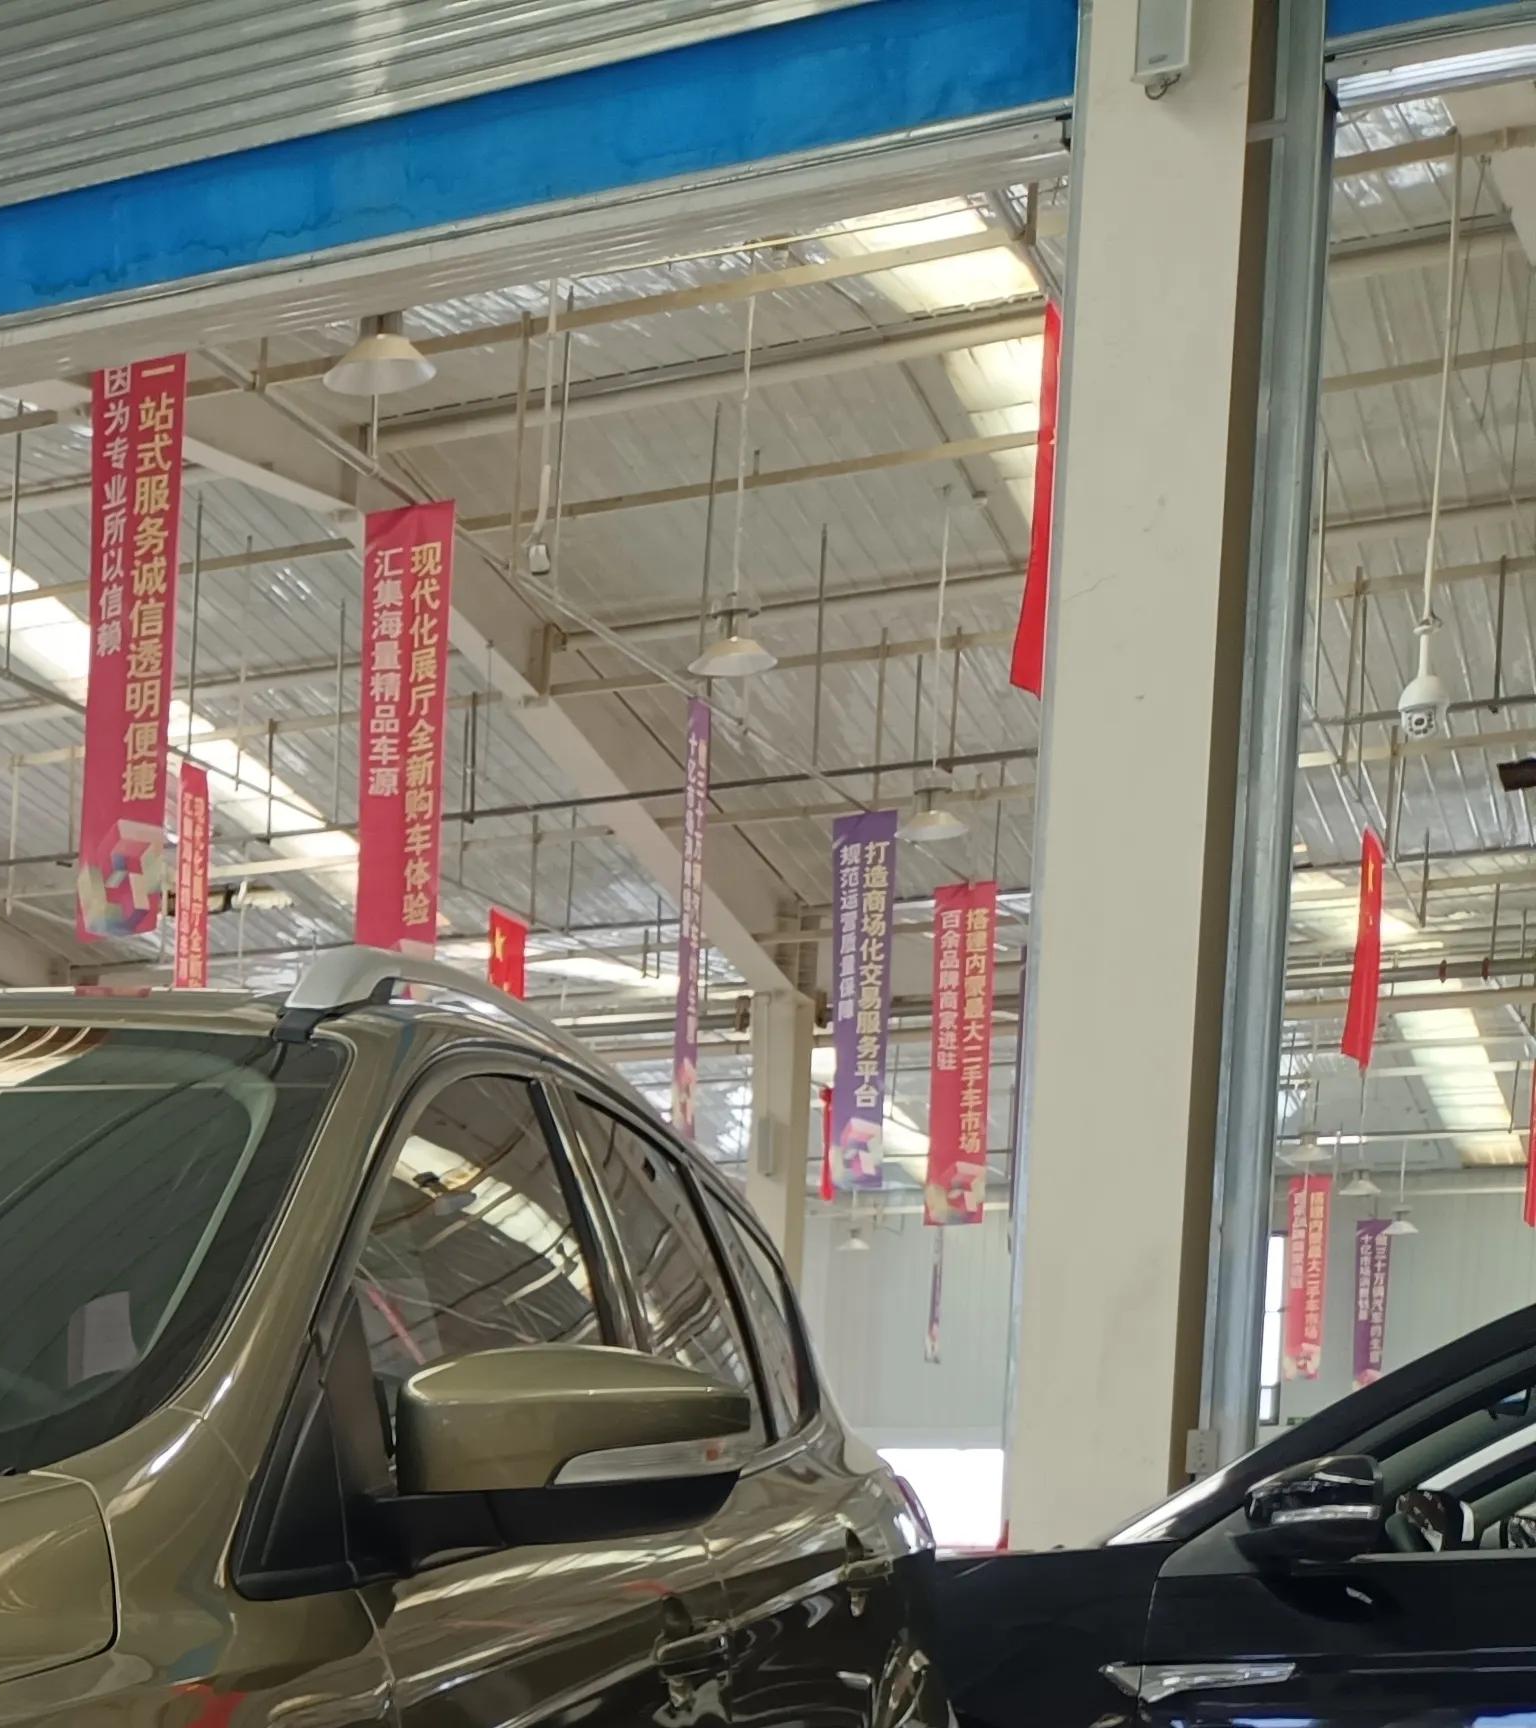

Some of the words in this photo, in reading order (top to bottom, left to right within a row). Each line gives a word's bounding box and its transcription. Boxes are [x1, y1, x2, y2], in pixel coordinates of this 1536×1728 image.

[95, 363, 133, 657] 因为专业所以信赖
[121, 362, 177, 802] 一站式服务诚信透明便捷
[367, 547, 404, 797] 汇集海量精品车源
[401, 540, 443, 927] 现代化展厅全新购车体验
[853, 841, 891, 1108] 打造商场化交易服务平台
[959, 907, 991, 1153] 搭建内蒙最大二手车市场
